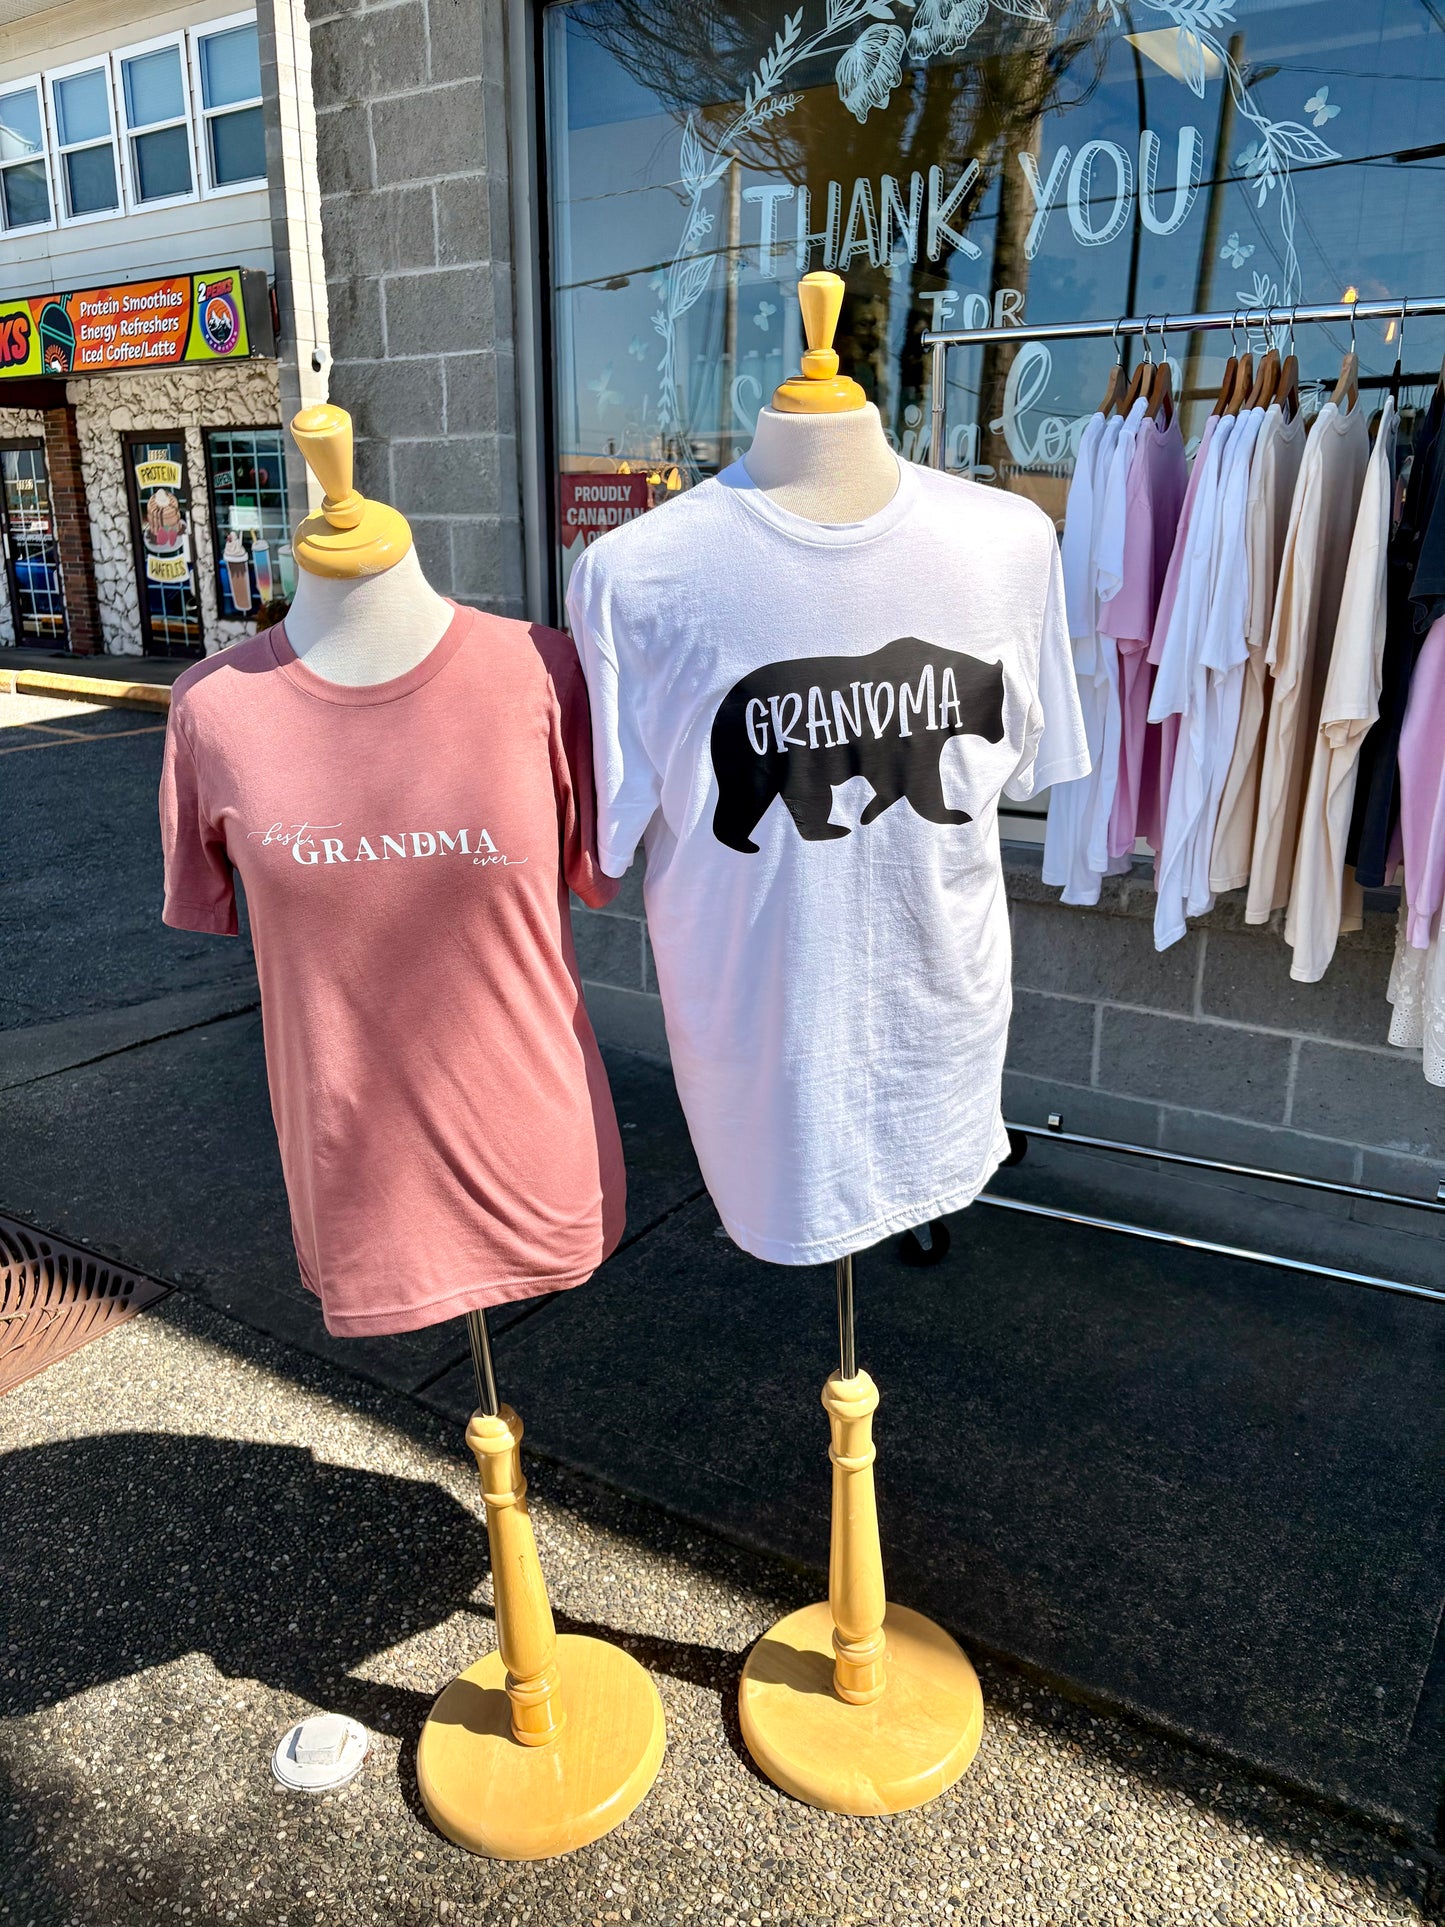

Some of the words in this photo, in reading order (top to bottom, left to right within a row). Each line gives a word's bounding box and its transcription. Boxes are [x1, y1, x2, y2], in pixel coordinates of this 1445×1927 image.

[742, 158, 982, 279] THANK
[1018, 126, 1204, 261] YOU
[80, 298, 120, 318] Protein
[123, 289, 183, 312] Smoothies
[919, 288, 1027, 333] FOR
[81, 323, 118, 344] Energy
[121, 315, 179, 337] Refreshers
[82, 346, 104, 363] Iced
[107, 340, 176, 362] Coffee/Latte
[141, 466, 176, 483] PROTEIN
[574, 485, 632, 502] PROUDLY
[150, 561, 187, 578] WAFFLES
[745, 664, 963, 756] GRANDMA
[247, 822, 342, 846] best
[292, 828, 499, 865] GRANDMA
[473, 854, 528, 866] ever
